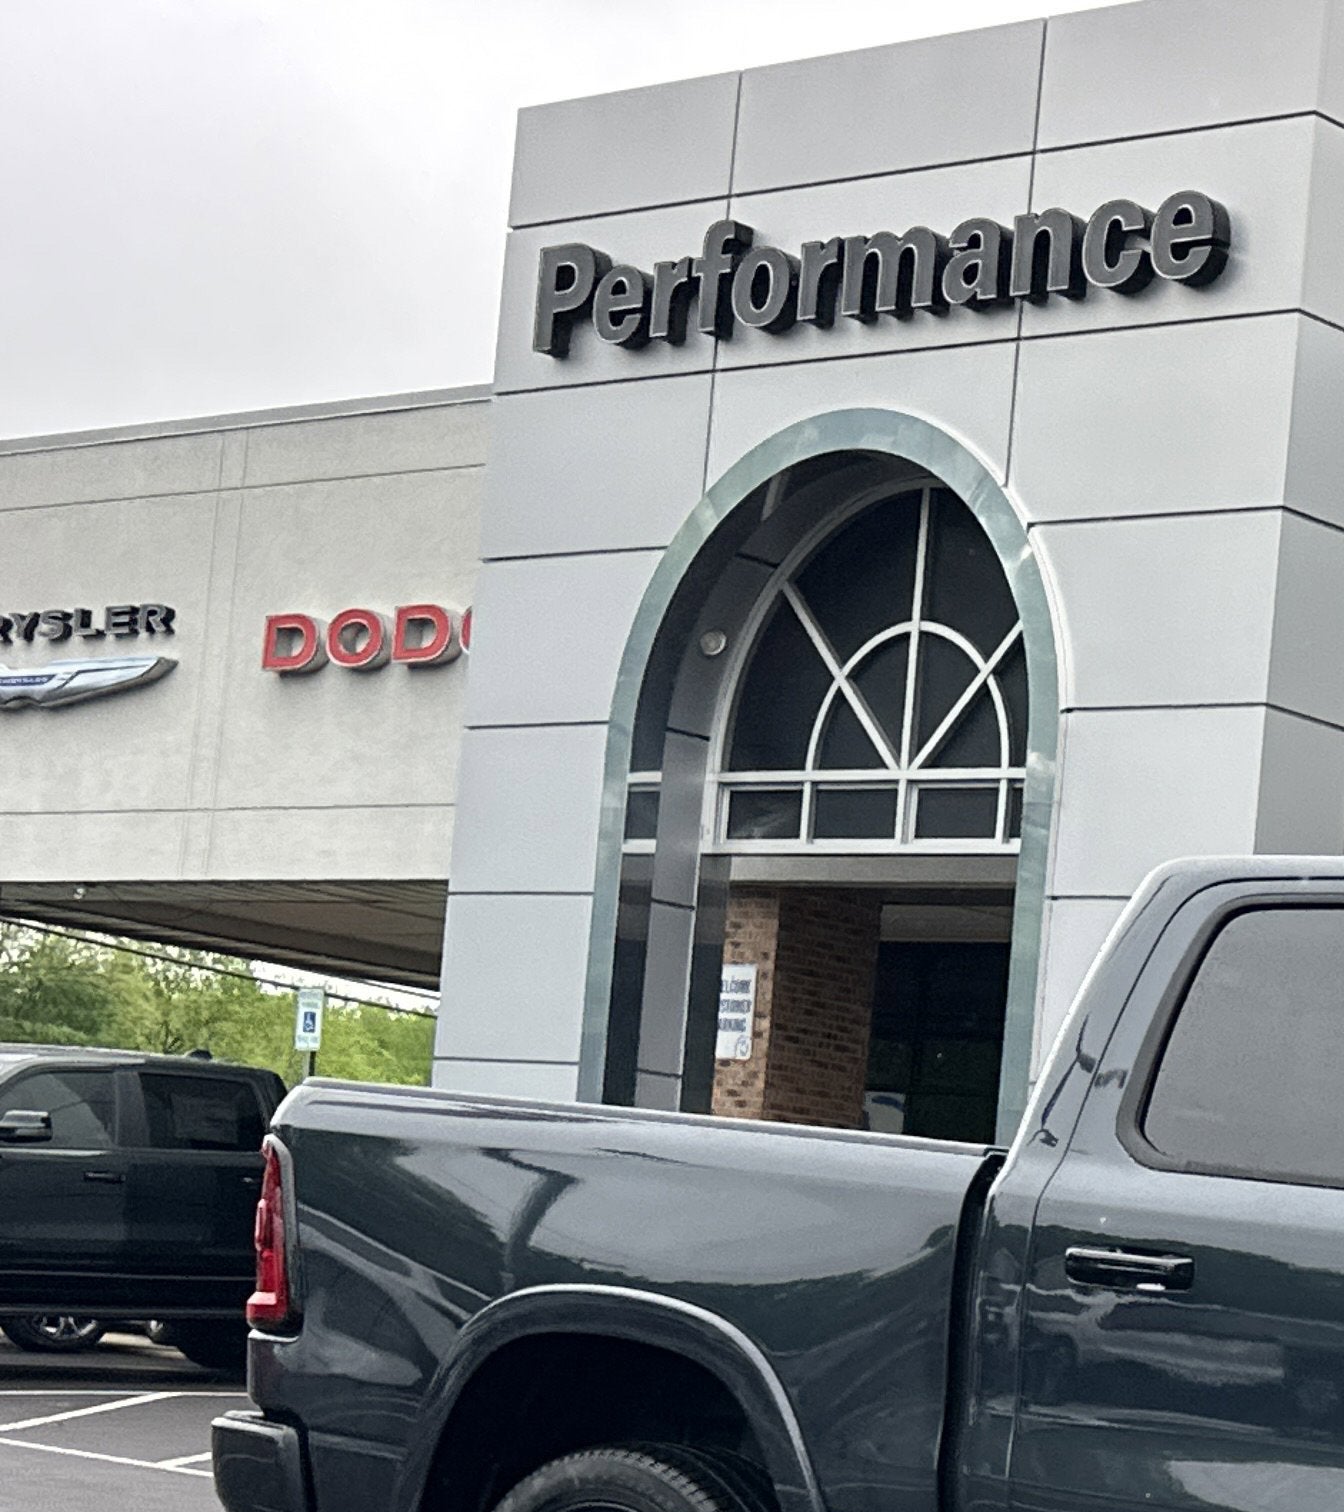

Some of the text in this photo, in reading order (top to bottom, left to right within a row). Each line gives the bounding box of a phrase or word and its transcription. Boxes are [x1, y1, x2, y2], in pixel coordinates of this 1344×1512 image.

[533, 190, 1231, 358] Performance
[0, 603, 176, 643] YSLER
[262, 603, 473, 668] DOD
